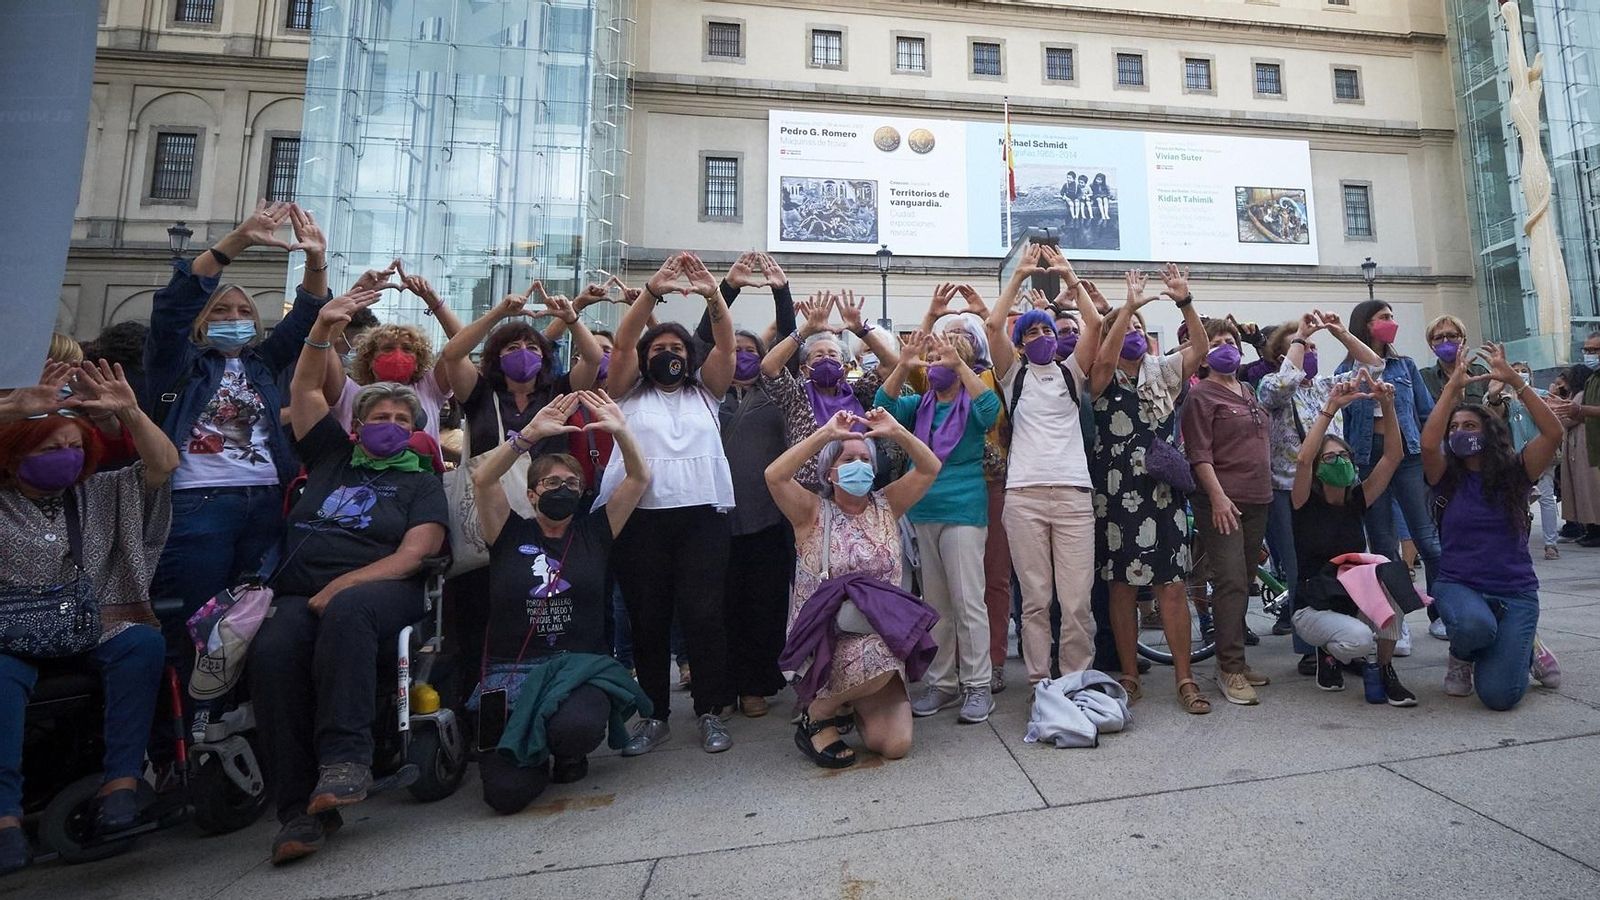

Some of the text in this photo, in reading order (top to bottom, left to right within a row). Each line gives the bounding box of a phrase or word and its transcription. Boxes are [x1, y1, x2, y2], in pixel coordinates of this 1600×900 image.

[780, 126, 857, 138] Pedro G. Romero
[998, 138, 1068, 149] Mchael Schmidt
[1155, 152, 1203, 162] Vivian Suter
[889, 188, 950, 198] Territorios de
[889, 199, 942, 209] vanguardia.
[1182, 196, 1214, 204] Tahimik
[536, 623, 564, 633] LA GANA
